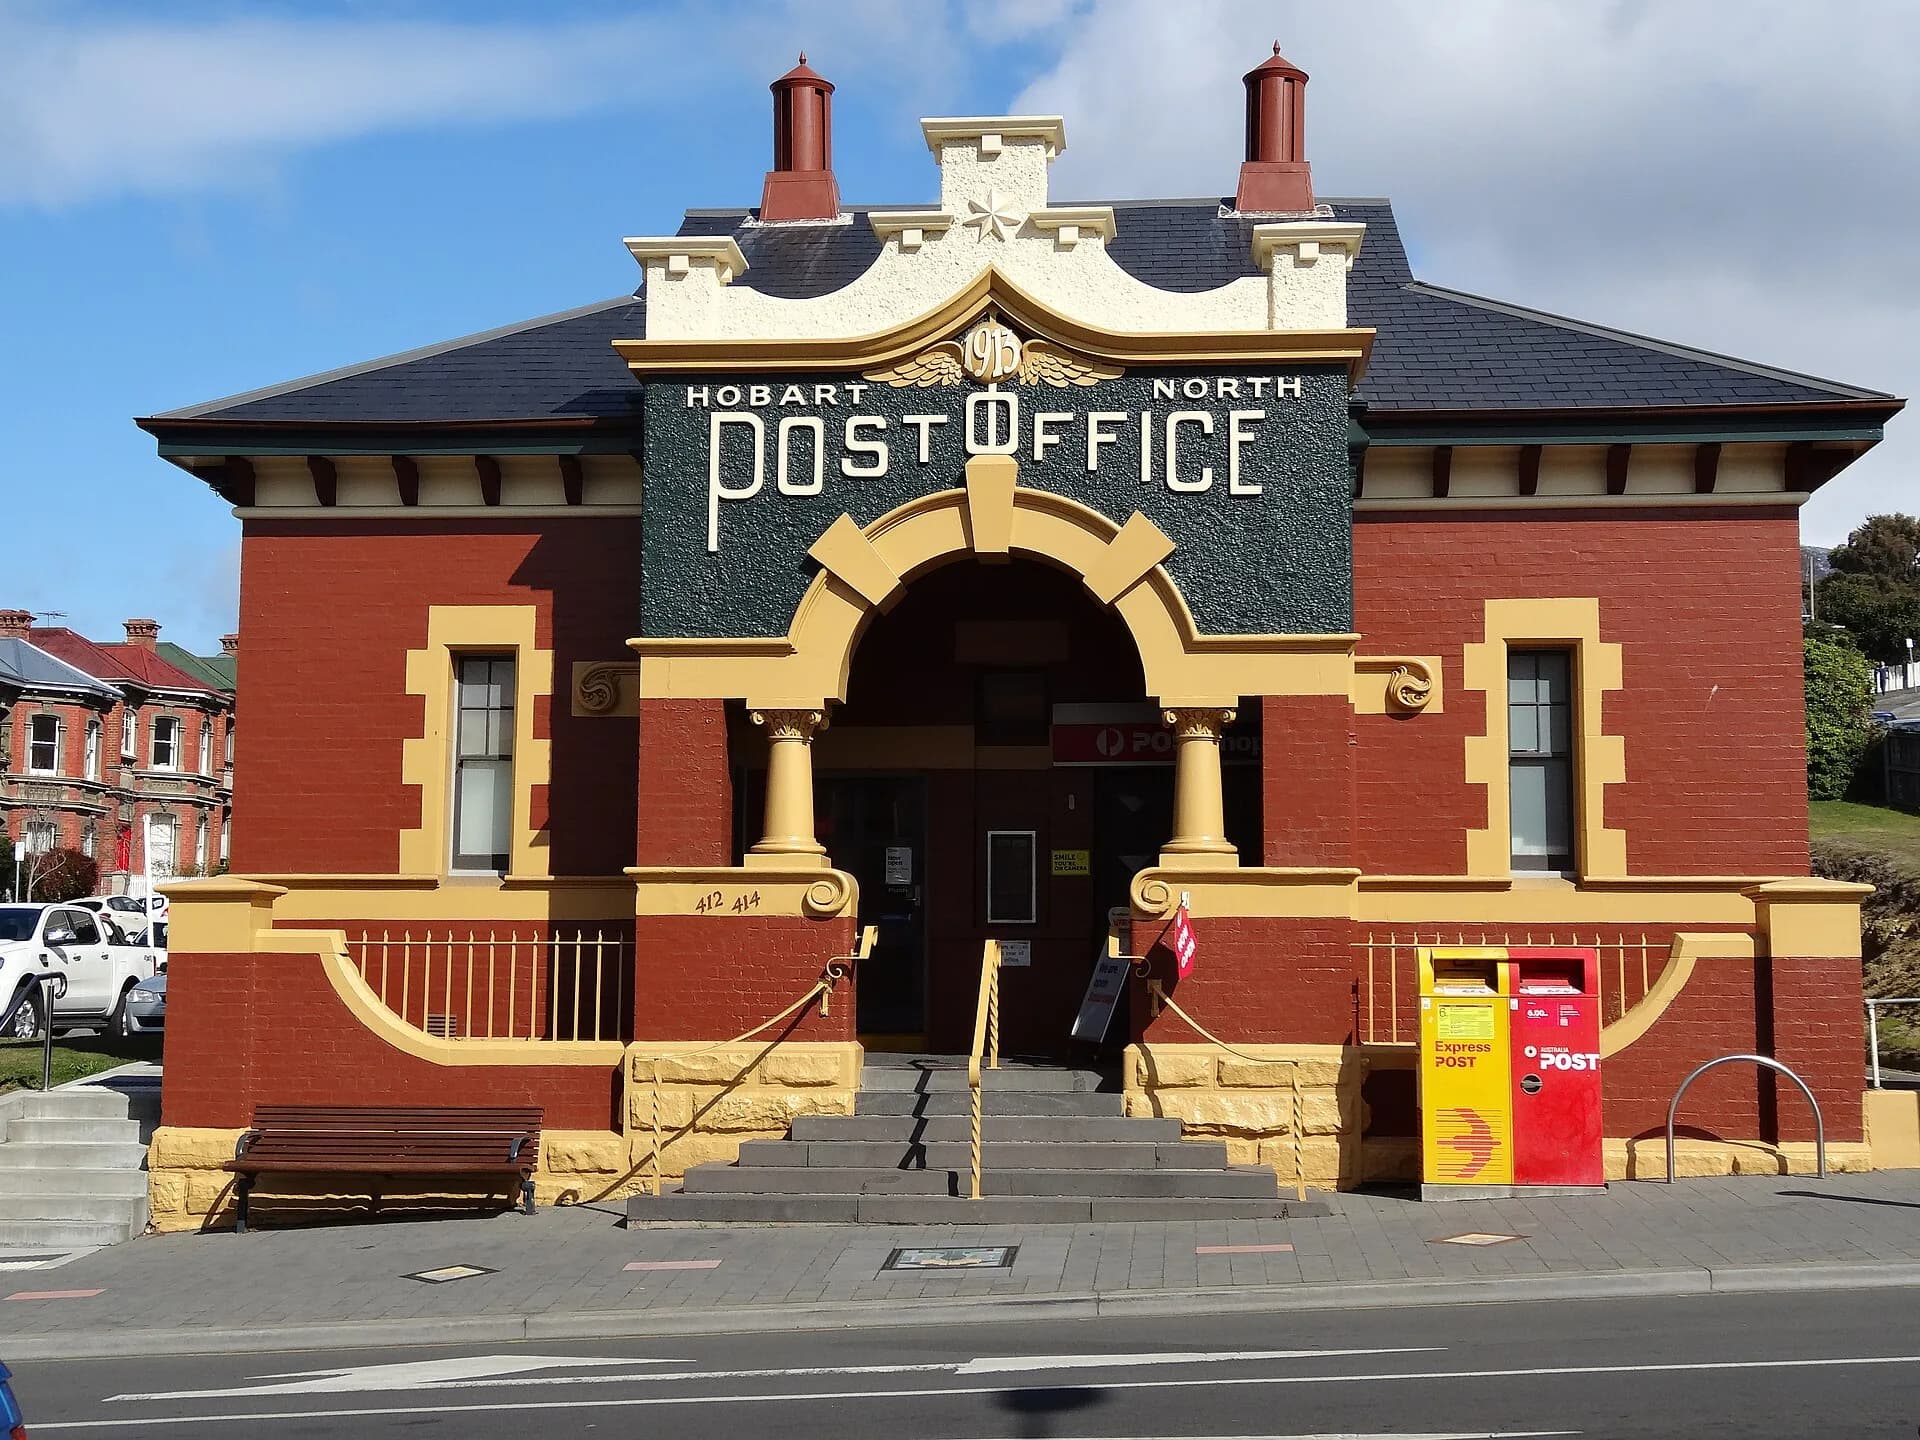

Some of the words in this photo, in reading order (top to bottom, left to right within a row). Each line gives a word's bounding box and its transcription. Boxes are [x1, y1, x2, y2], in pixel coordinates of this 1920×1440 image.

[964, 328, 1021, 378] 1913
[687, 384, 868, 408] HOBART
[1152, 376, 1302, 399] NORTH
[707, 412, 948, 552] POST
[965, 391, 1267, 496] OFFICE
[695, 891, 724, 914] 412
[731, 891, 761, 914] 414
[1177, 924, 1189, 953] NOW
[1181, 938, 1196, 969] OPEN
[1435, 1040, 1491, 1055] Express
[1435, 1056, 1476, 1068] POST
[1540, 1053, 1601, 1071] POST
